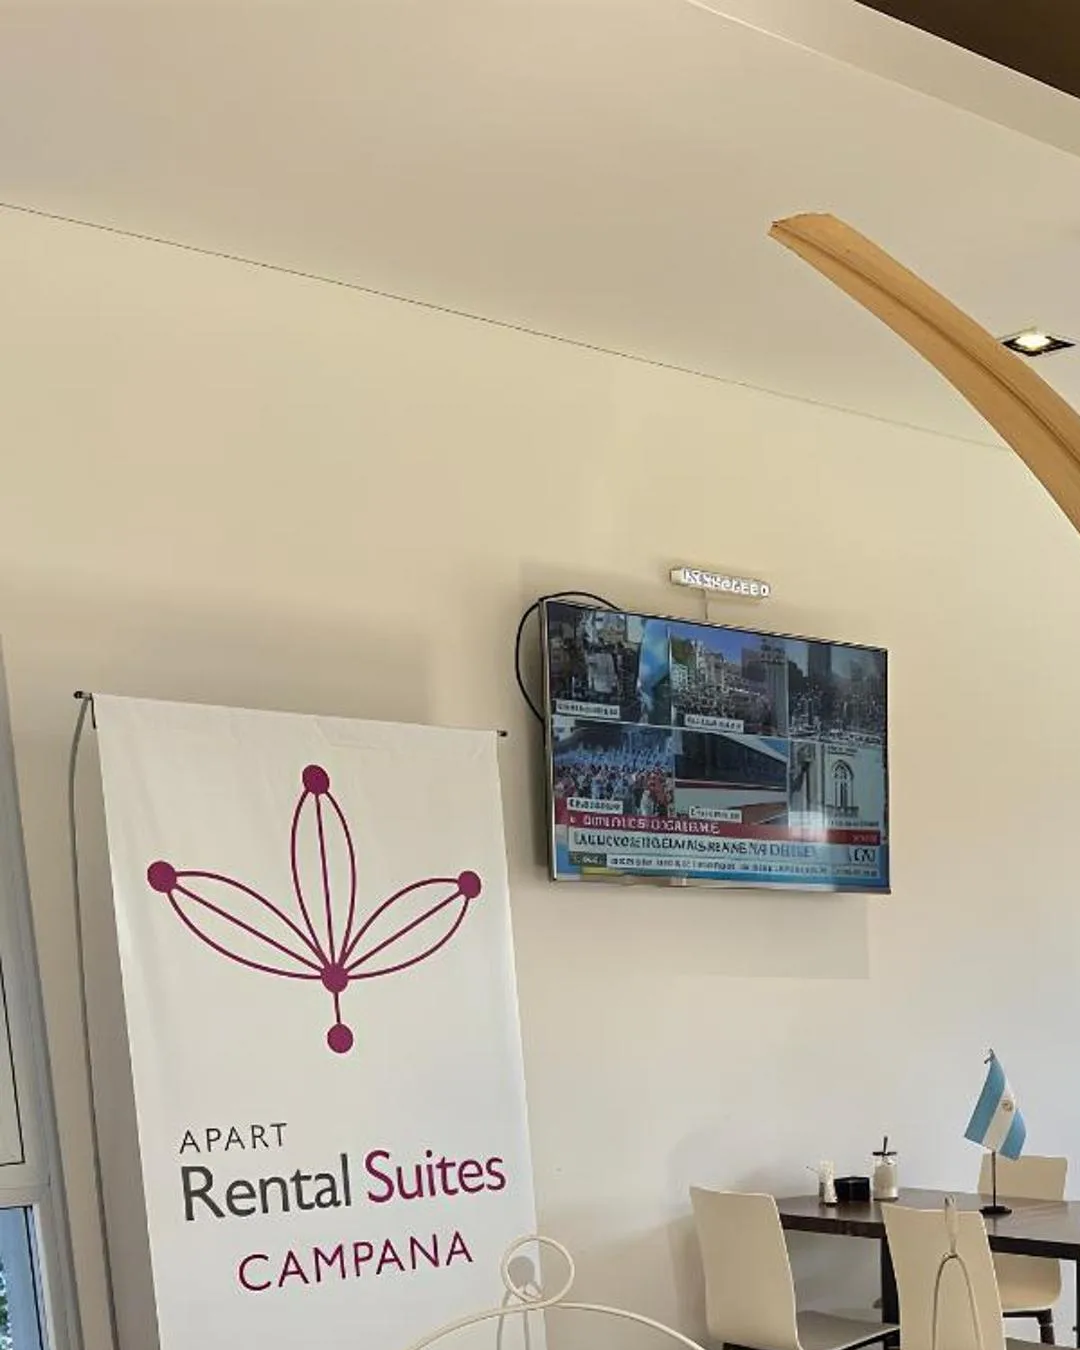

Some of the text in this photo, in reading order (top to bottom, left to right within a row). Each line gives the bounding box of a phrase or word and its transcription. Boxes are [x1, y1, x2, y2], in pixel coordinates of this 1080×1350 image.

[179, 1122, 288, 1154] APART
[181, 1149, 506, 1221] Rental Suites
[238, 1231, 474, 1291] CAMPANA
